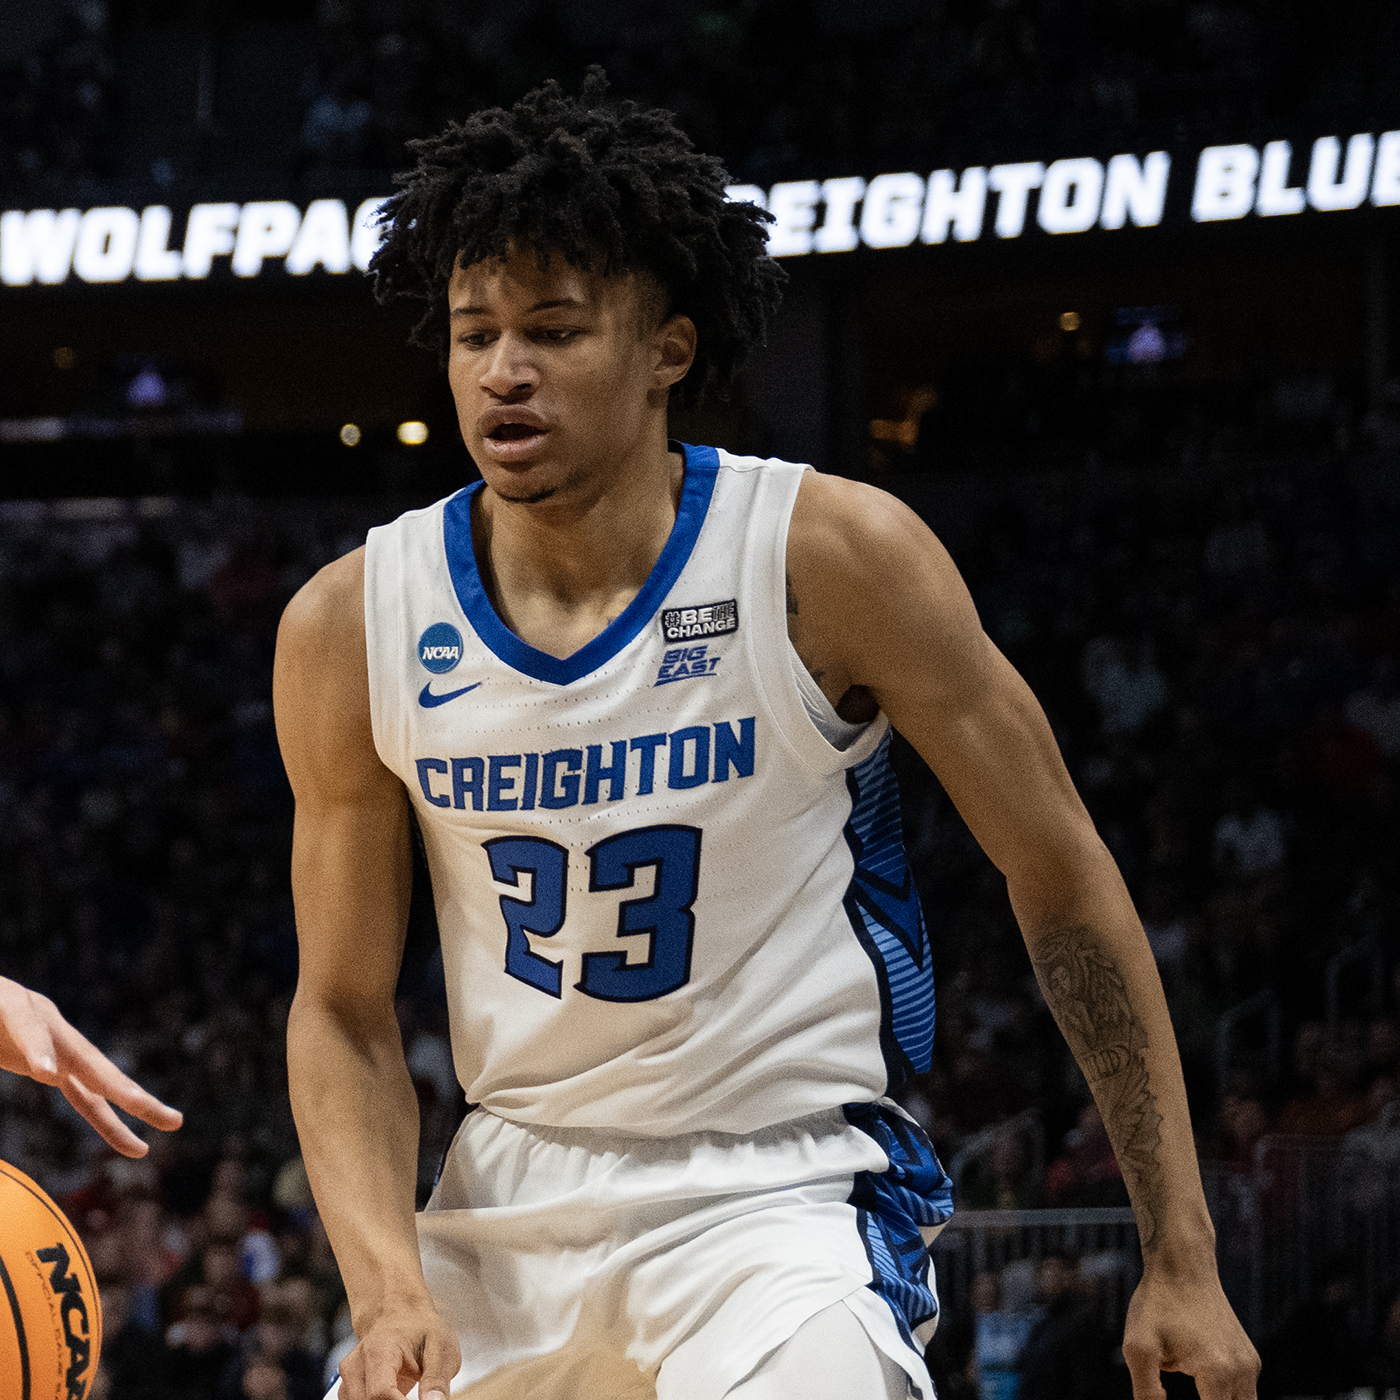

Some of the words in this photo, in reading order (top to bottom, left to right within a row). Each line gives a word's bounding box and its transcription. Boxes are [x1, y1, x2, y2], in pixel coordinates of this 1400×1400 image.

[0, 198, 397, 287] WOLFPAC
[667, 618, 736, 639] CHANGE
[422, 646, 460, 660] NCAA
[662, 645, 708, 665] BIG
[657, 657, 721, 680] EAST
[415, 717, 756, 812] CREIGHTON
[481, 824, 703, 1004] 23
